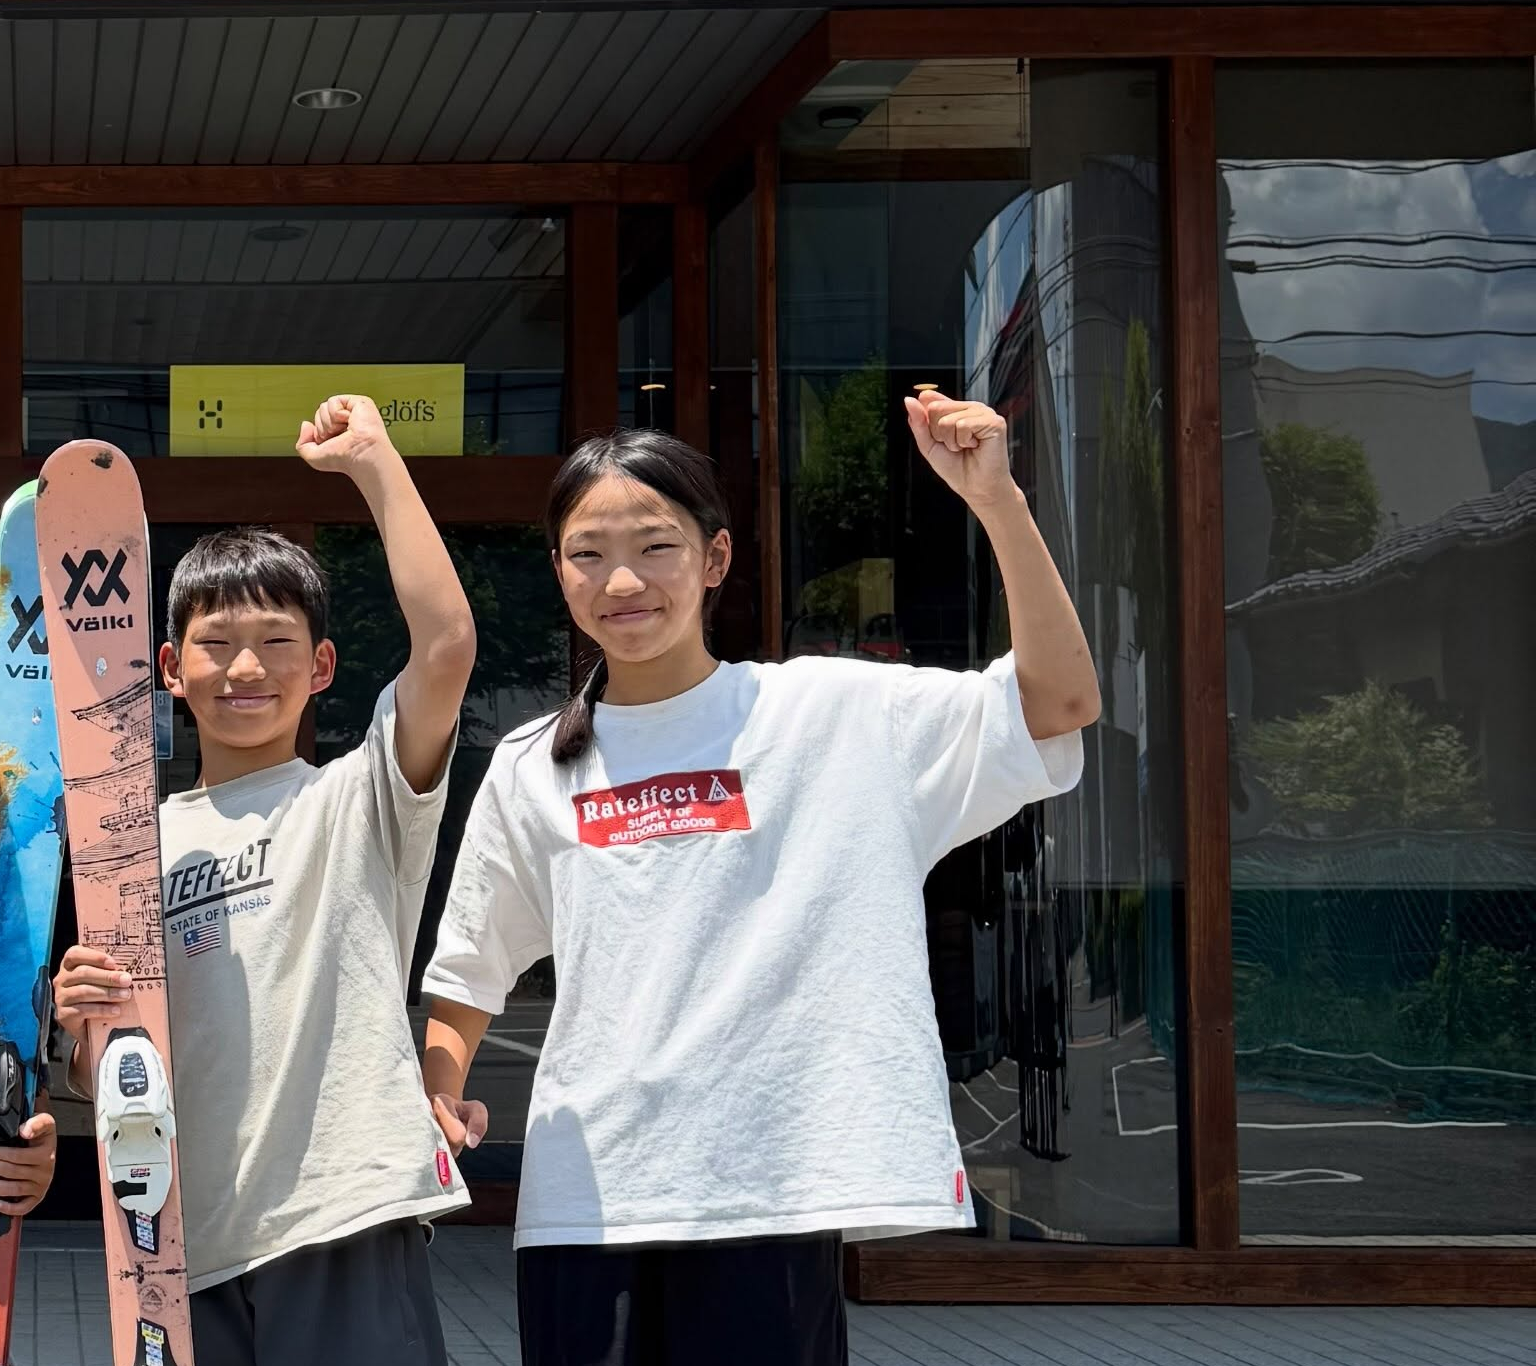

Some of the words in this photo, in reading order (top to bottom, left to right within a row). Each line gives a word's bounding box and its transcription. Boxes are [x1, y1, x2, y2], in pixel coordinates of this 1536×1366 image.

[379, 399, 435, 427] glöfs
[66, 614, 134, 632] Völkl
[5, 663, 52, 681] Völ
[581, 783, 700, 823] Rateffect
[608, 823, 667, 843] OUTDOOR
[670, 816, 717, 830] GOODS
[627, 807, 673, 830] SUPPLY
[675, 806, 694, 817] OF
[167, 838, 272, 907] TEFFECT
[170, 913, 202, 934] STATE
[204, 908, 220, 922] OF
[223, 894, 272, 916] KANSAS
